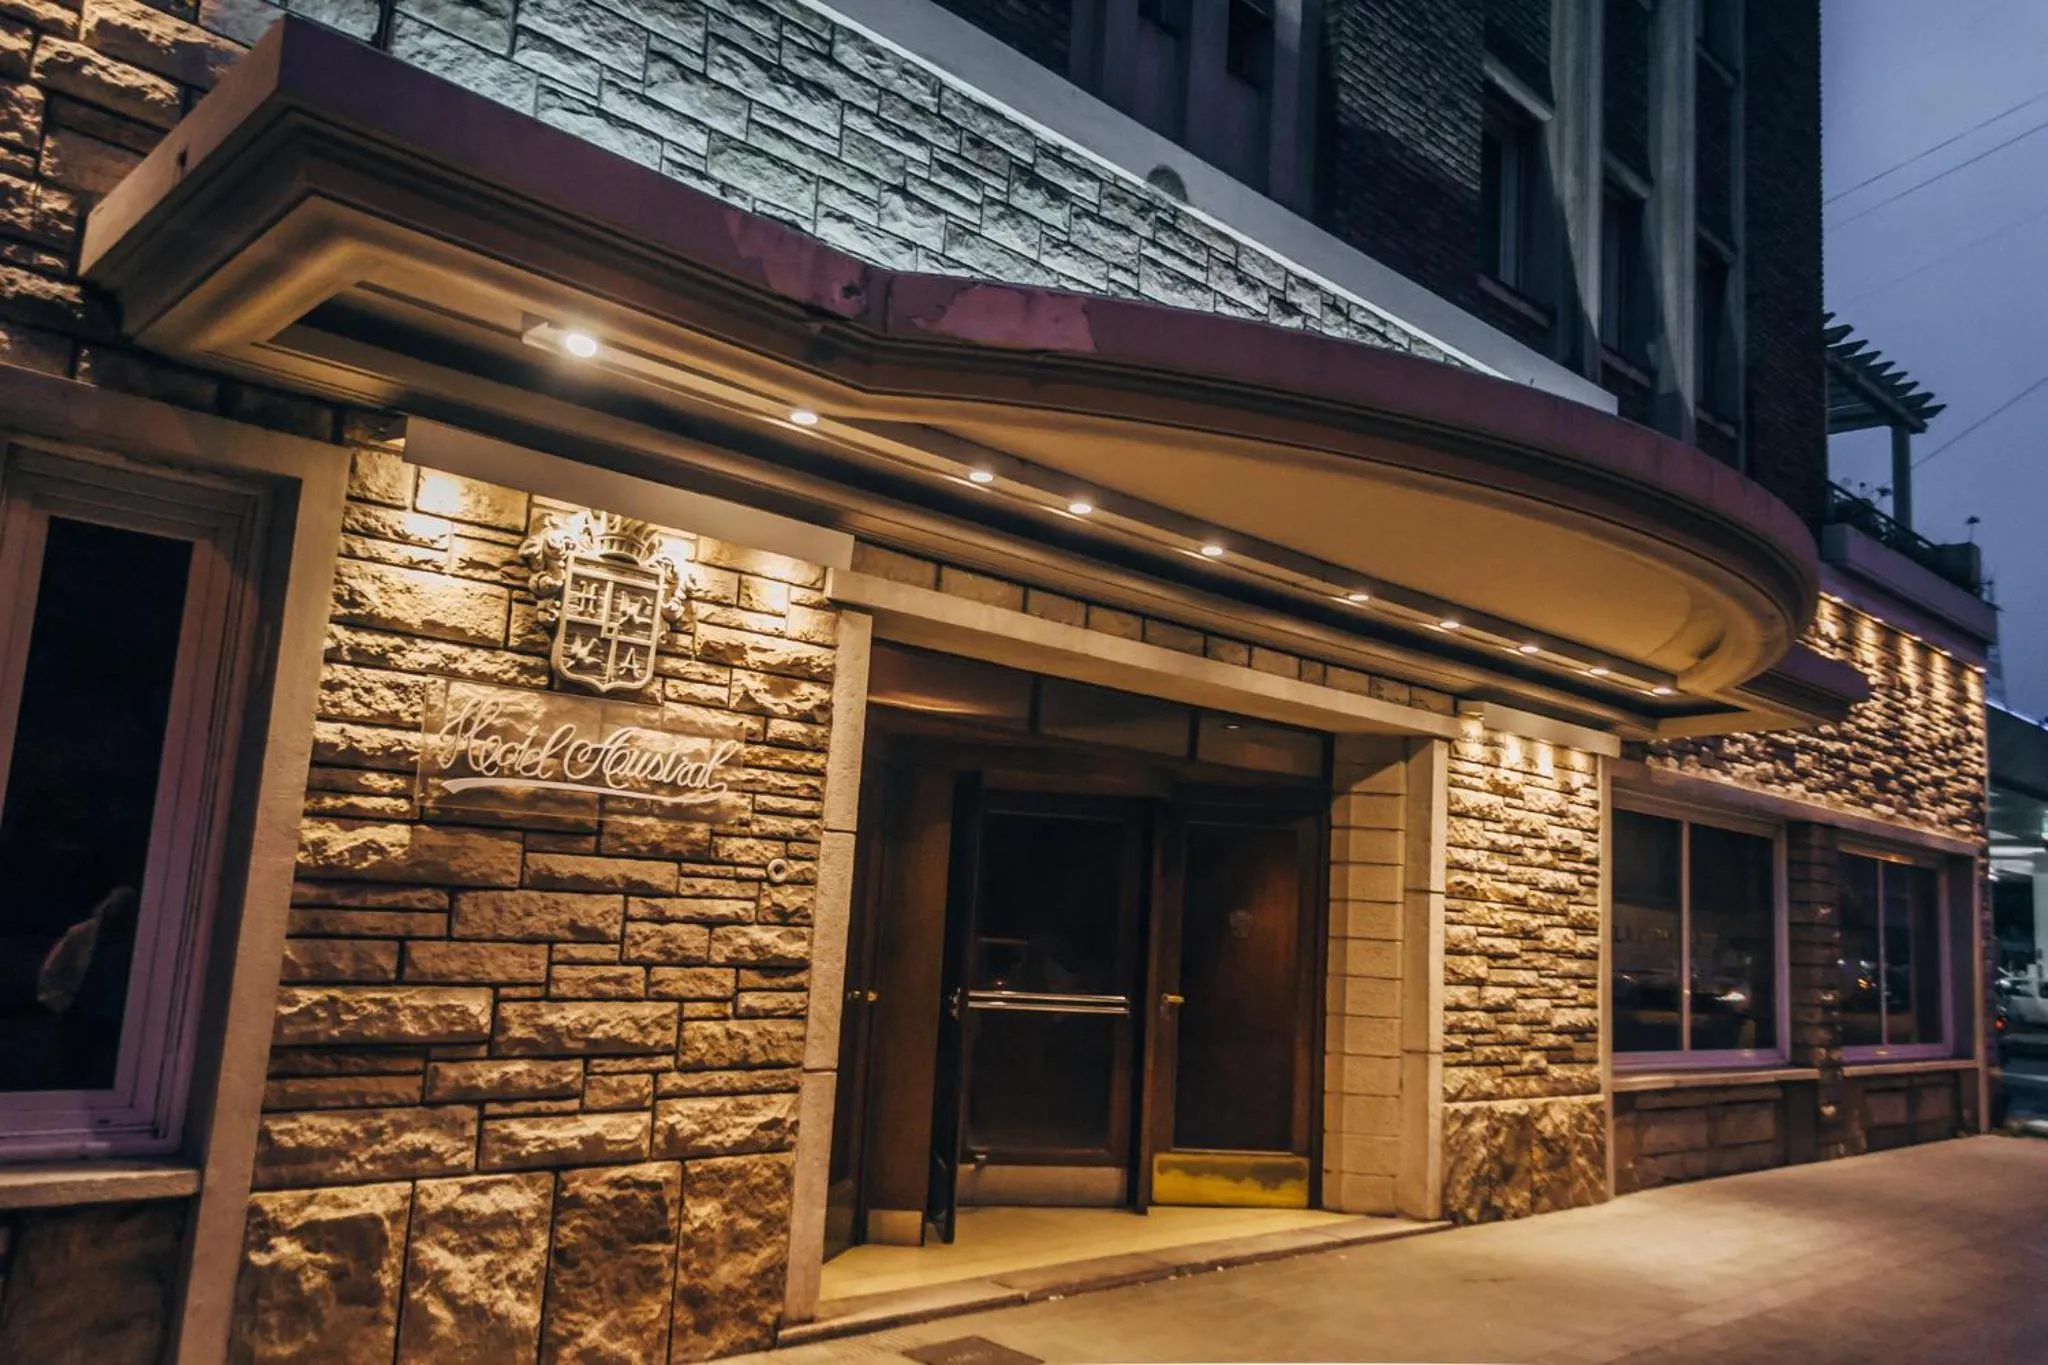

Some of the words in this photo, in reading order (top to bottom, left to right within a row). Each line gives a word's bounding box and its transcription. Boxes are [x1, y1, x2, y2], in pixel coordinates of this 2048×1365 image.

[577, 580, 598, 615] H
[619, 647, 642, 678] A
[438, 698, 576, 779] Hotel
[562, 726, 739, 793] Austral
